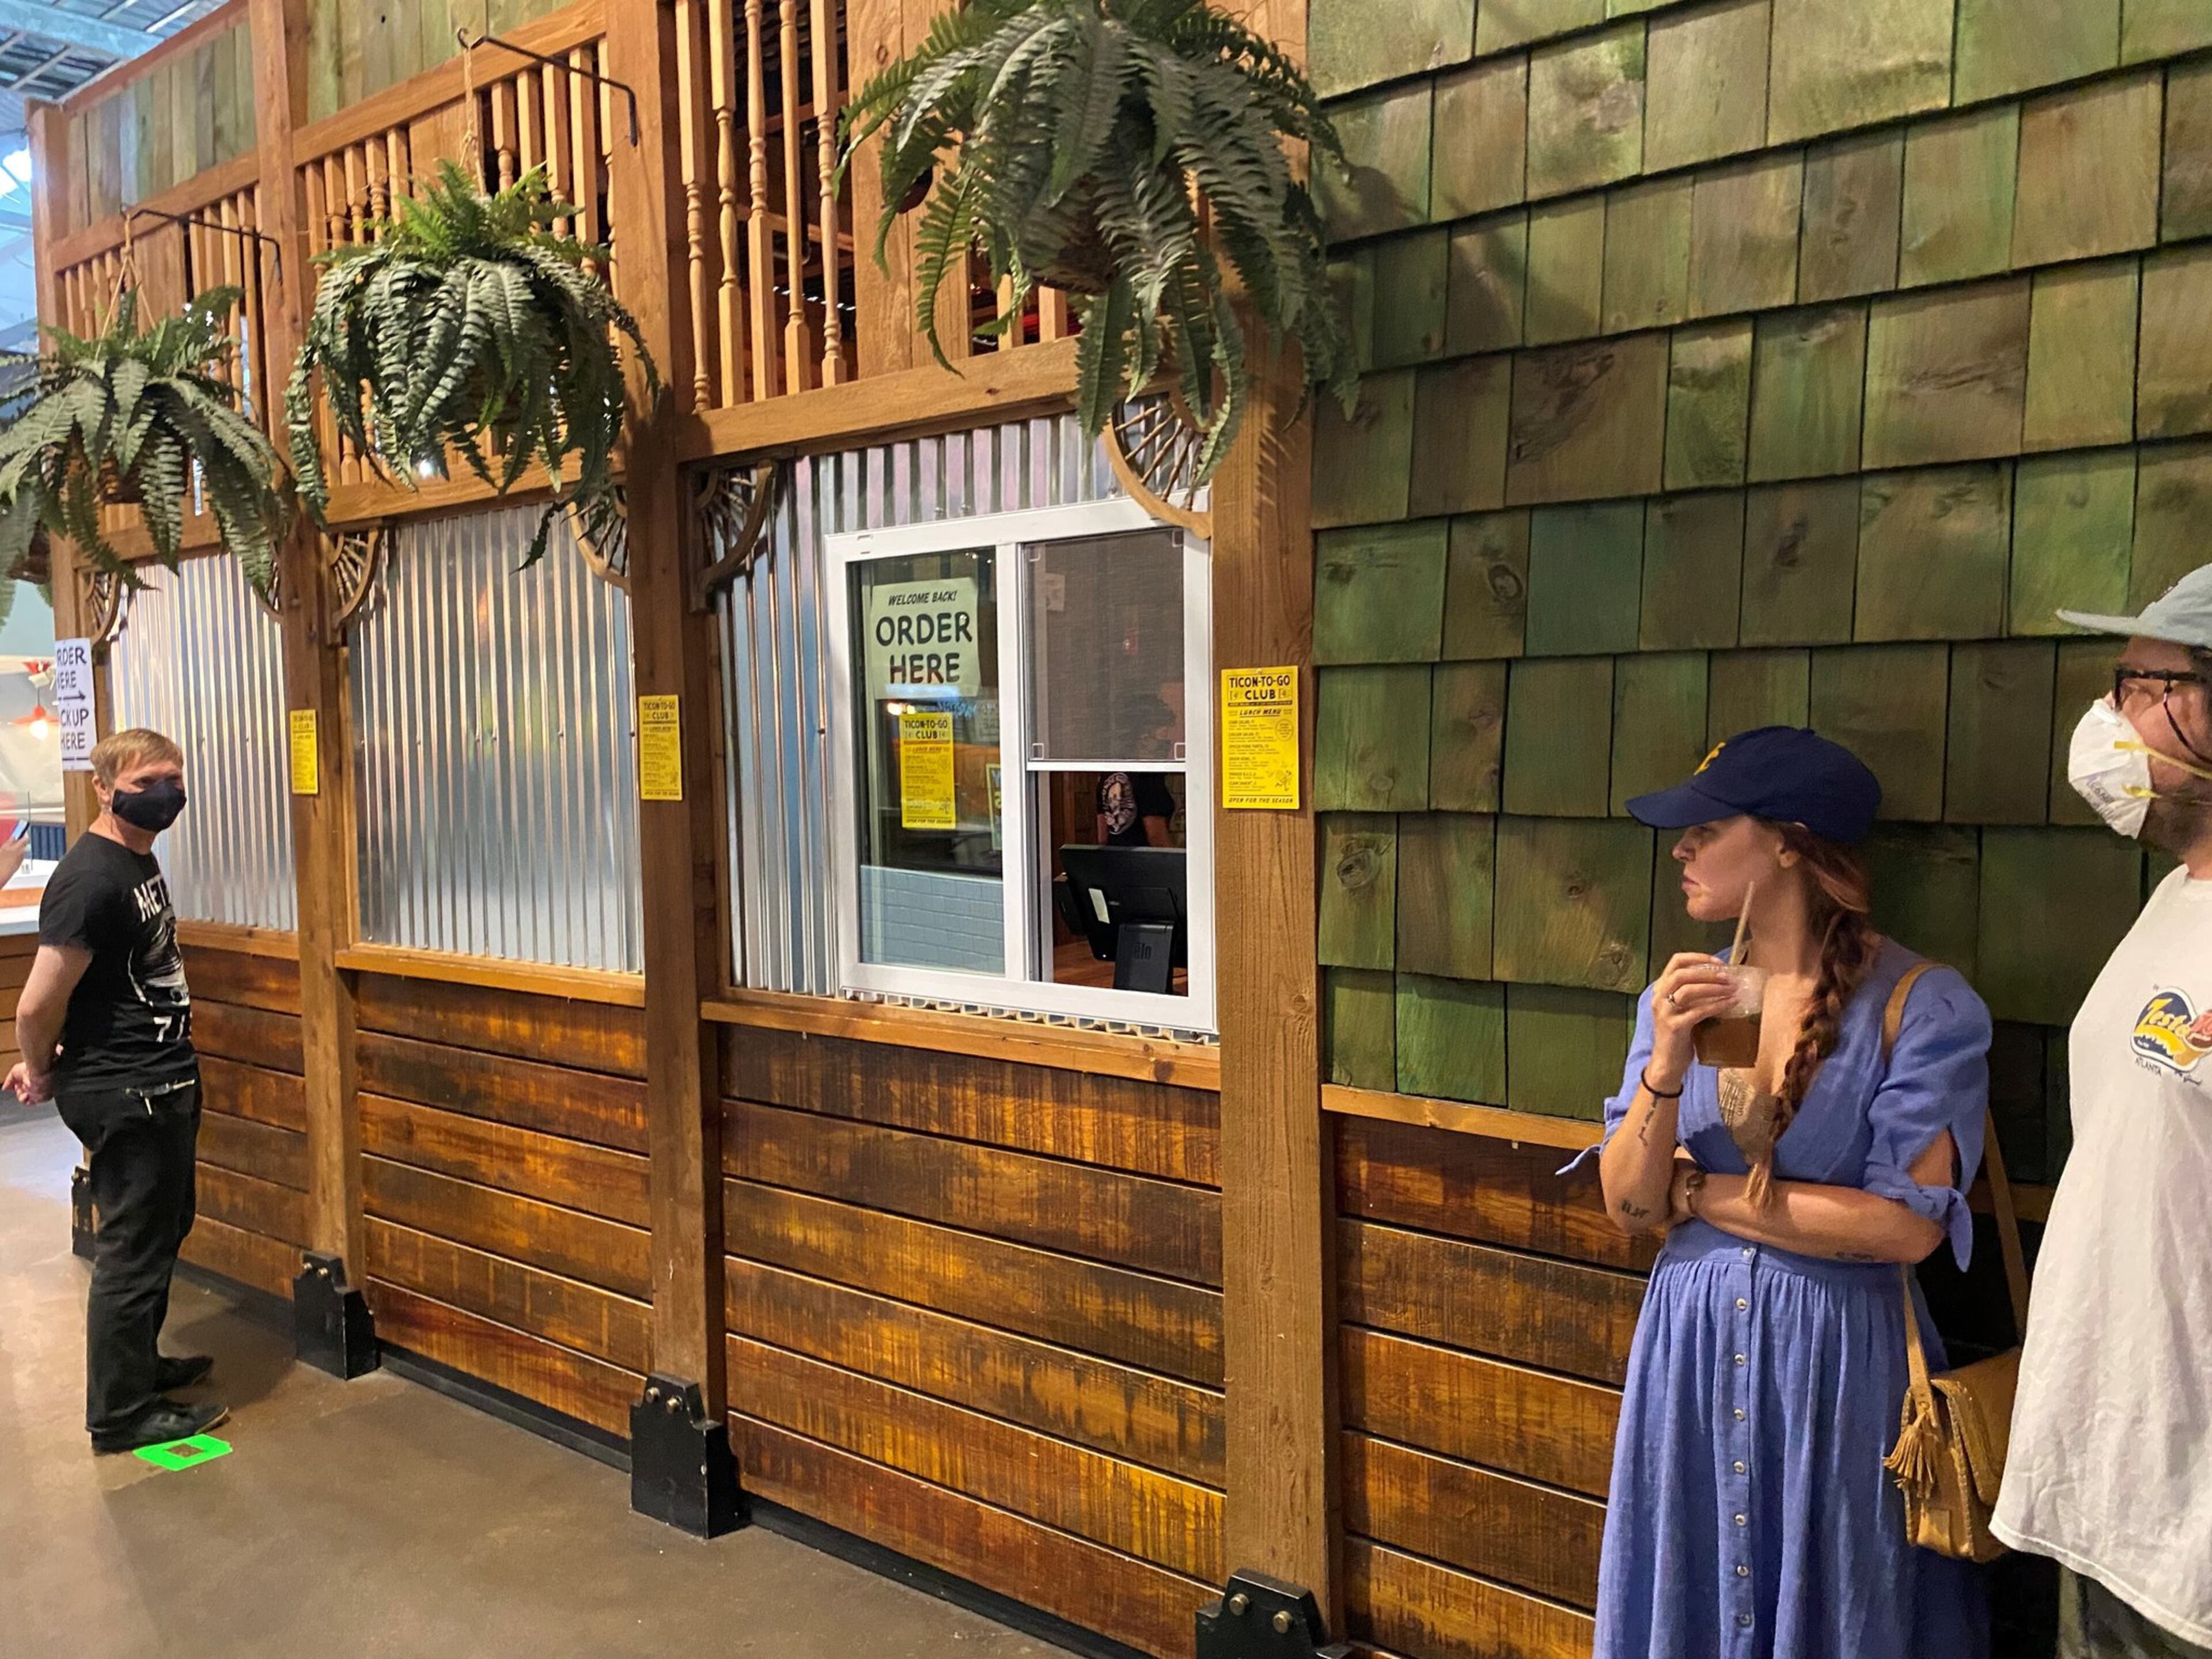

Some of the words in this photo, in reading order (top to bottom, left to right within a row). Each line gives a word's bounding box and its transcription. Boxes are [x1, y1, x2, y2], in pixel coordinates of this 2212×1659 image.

[888, 592, 930, 606] WELCOME
[932, 590, 957, 602] BACK!
[876, 611, 972, 646] ORDER
[889, 653, 960, 684] HERE
[1229, 675, 1290, 688] TICON-TO-GO
[1245, 690, 1275, 700] CLUB
[652, 711, 669, 719] CLUB
[904, 720, 948, 729] TICON-TO-GO
[916, 731, 938, 739] CLUB
